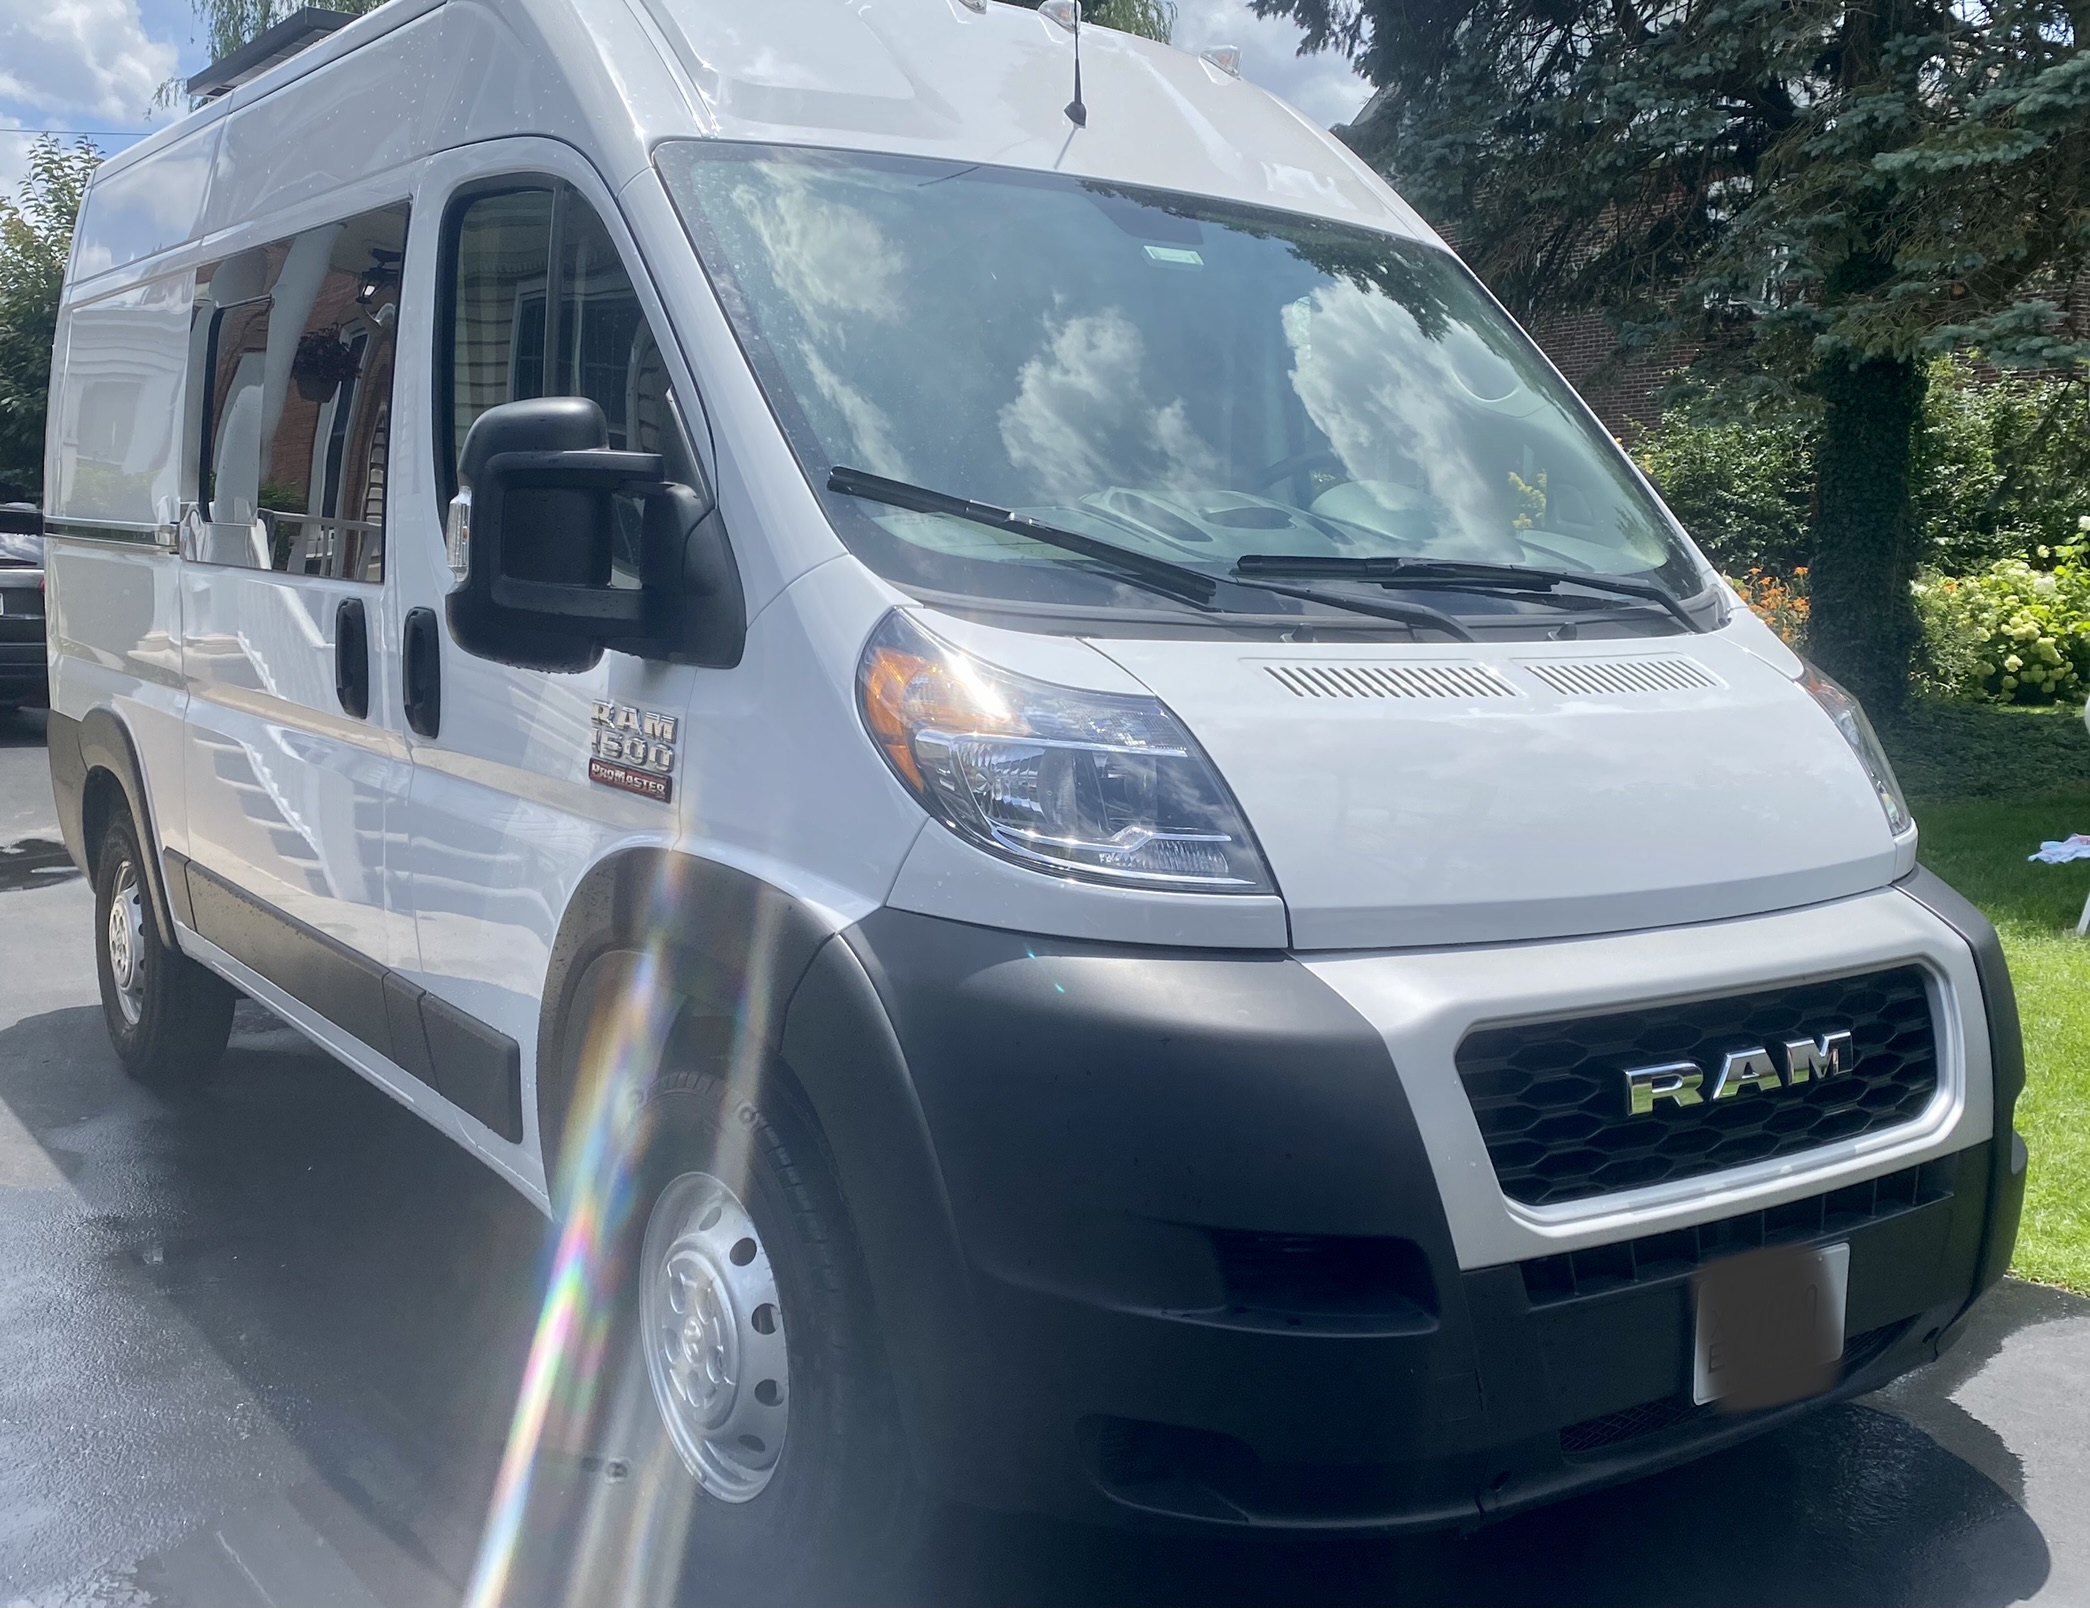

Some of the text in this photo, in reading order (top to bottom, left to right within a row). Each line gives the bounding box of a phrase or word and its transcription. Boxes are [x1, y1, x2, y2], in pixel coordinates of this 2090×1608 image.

[591, 699, 678, 744] RAM
[591, 727, 675, 773] 1500
[1623, 1031, 1854, 1116] RAM
